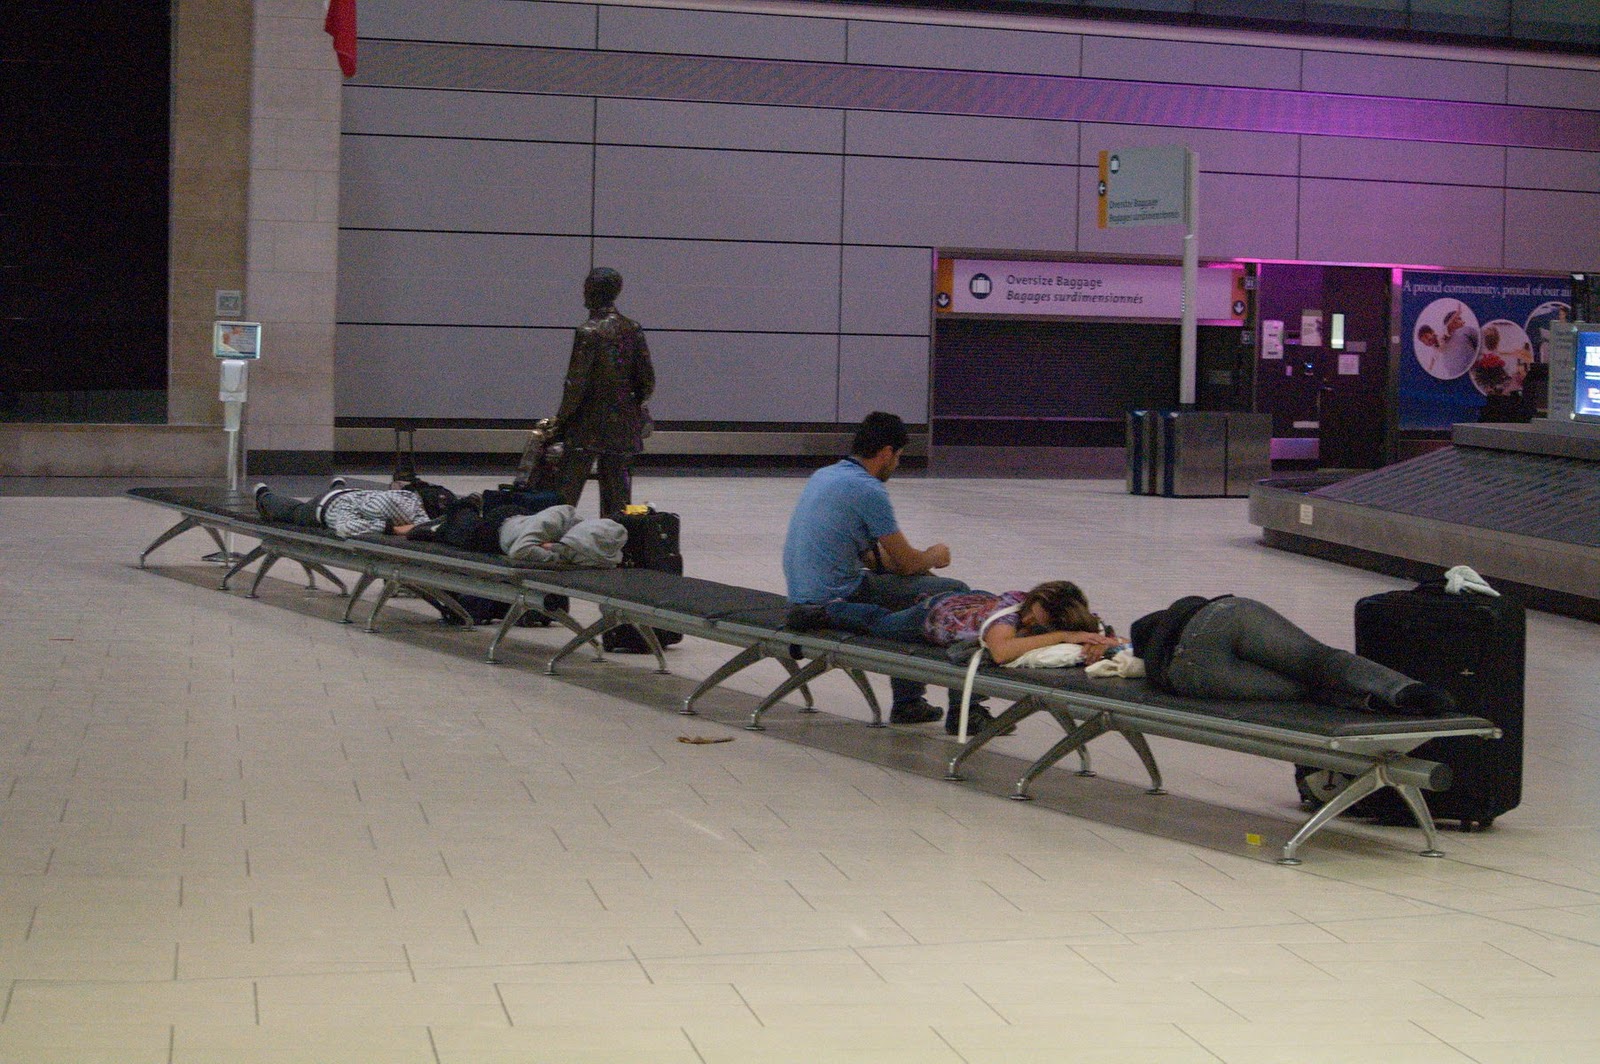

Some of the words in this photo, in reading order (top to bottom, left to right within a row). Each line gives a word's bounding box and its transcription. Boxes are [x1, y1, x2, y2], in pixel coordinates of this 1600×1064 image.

[1006, 274, 1053, 286] Oversize
[1056, 276, 1103, 290] Baggage
[1403, 281, 1411, 292] A
[1413, 281, 1442, 295] proud
[1503, 285, 1530, 298] proud
[1532, 285, 1542, 296] of
[1543, 287, 1560, 297] our
[1006, 290, 1051, 304] Bagages
[1053, 291, 1144, 304] surdimensionnés
